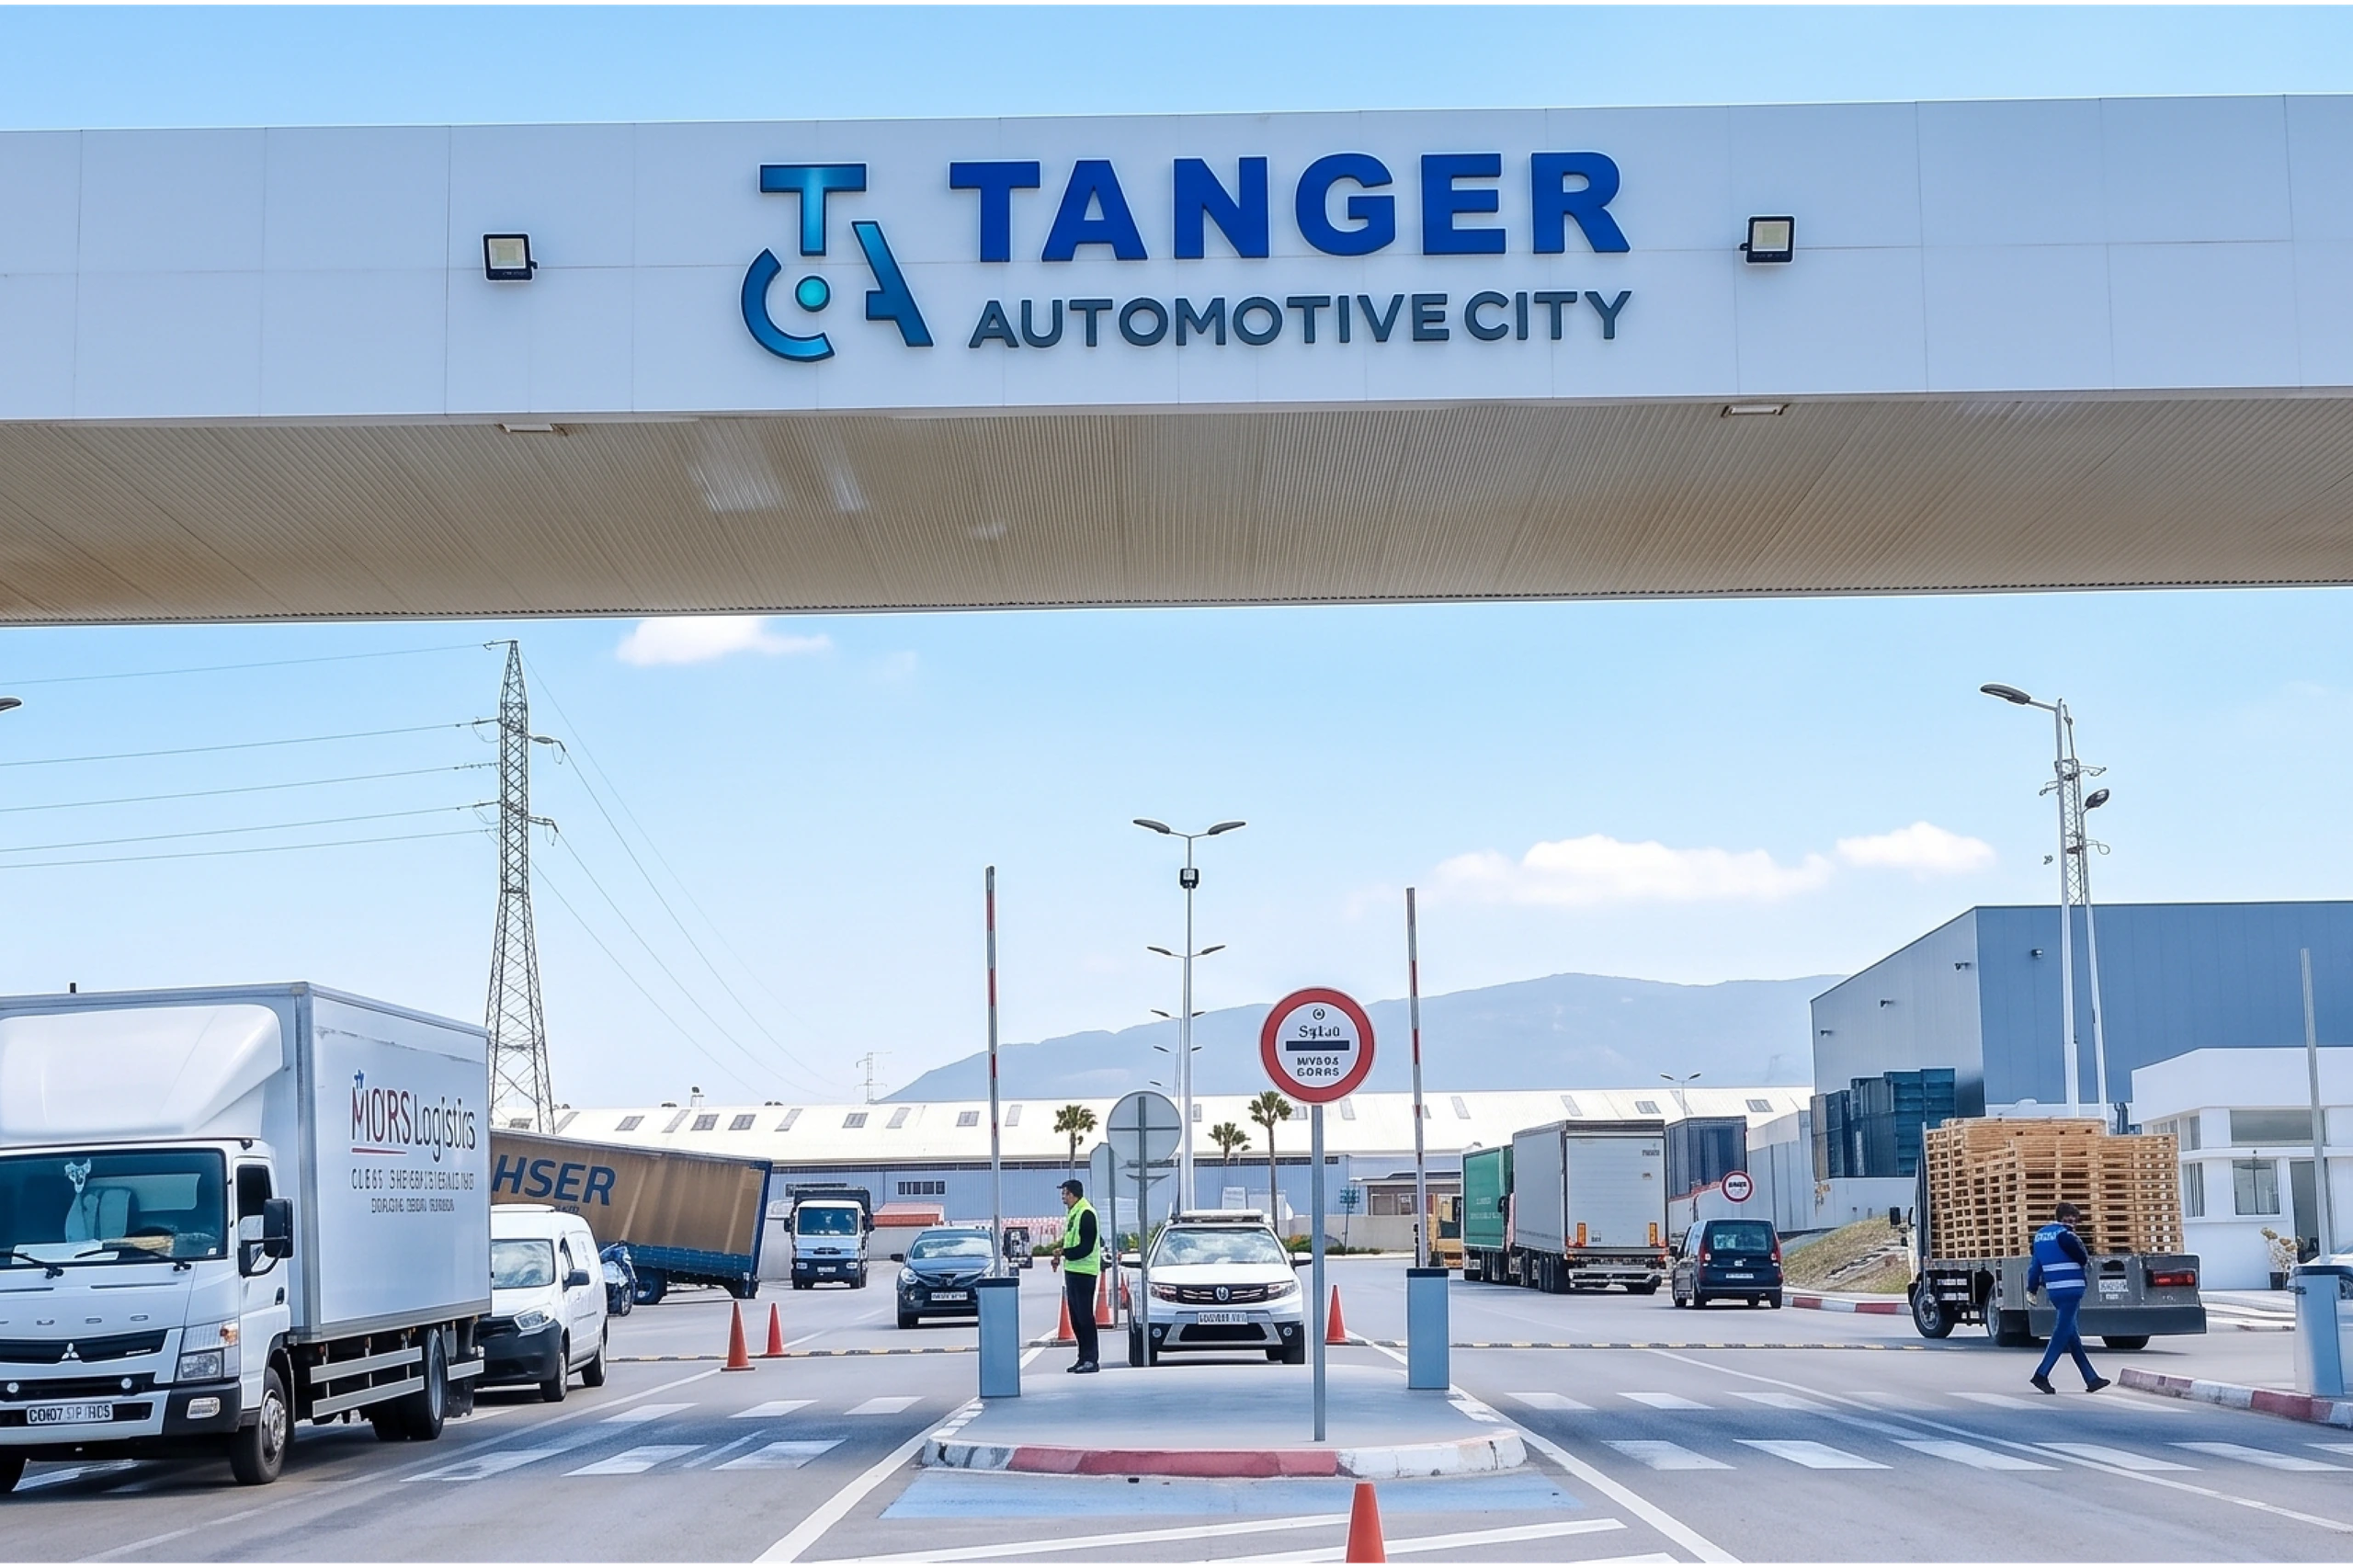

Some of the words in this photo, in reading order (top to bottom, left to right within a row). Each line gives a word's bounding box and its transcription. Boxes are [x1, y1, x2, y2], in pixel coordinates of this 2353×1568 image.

[948, 151, 1631, 264] TANGER
[968, 292, 1450, 350] AUTOMOTIVE
[1463, 290, 1632, 343] CITY
